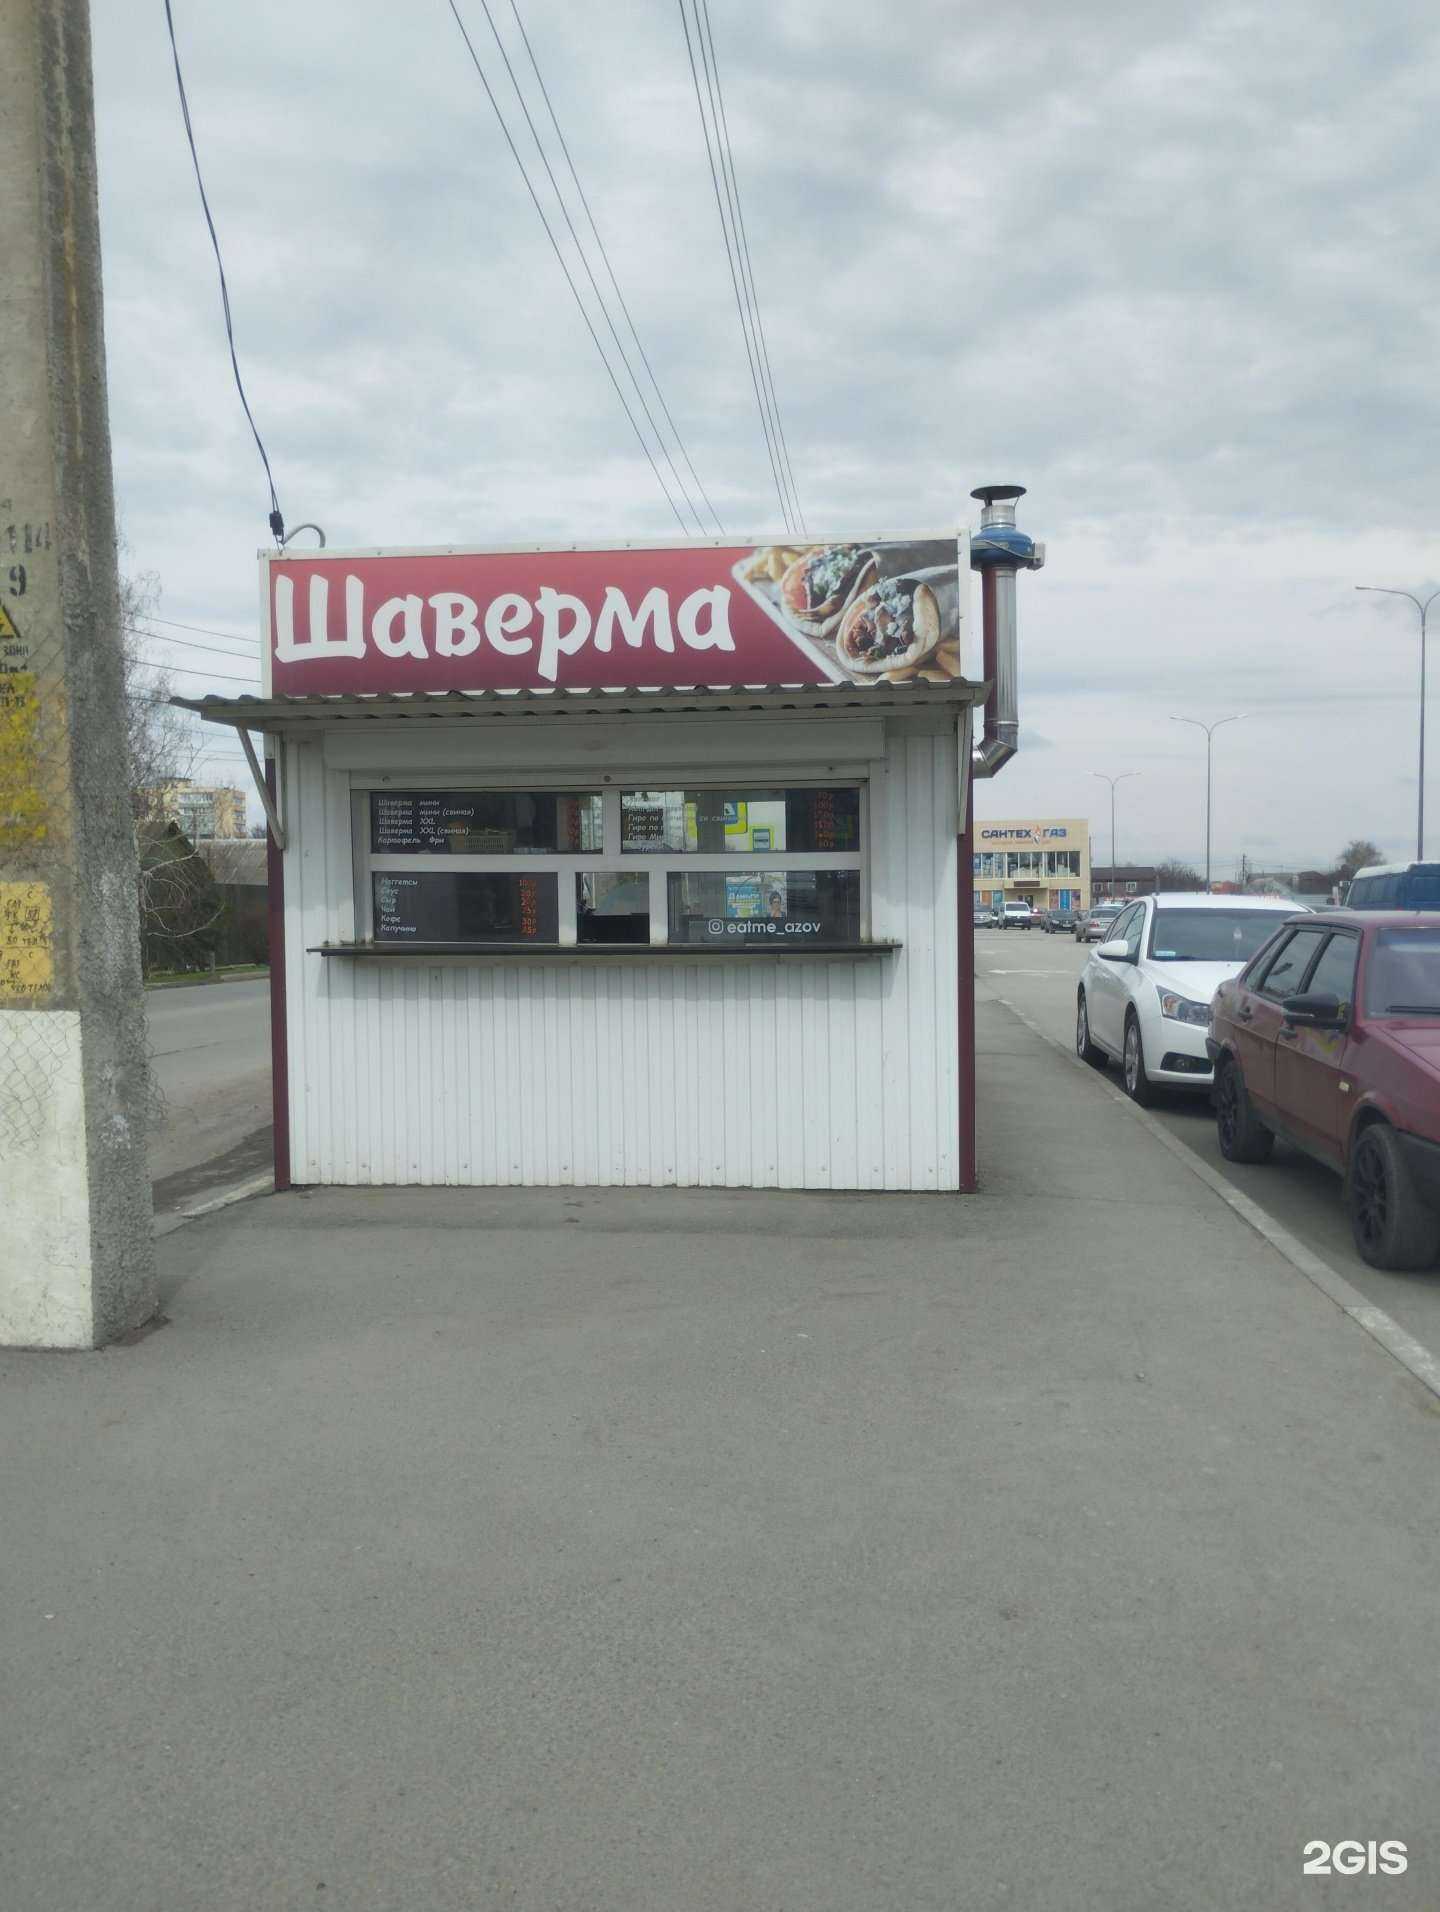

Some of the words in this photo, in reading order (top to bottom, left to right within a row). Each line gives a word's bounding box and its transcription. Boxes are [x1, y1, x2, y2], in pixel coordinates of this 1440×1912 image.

[273, 572, 736, 682] Шаверма
[419, 816, 436, 825] XXL
[419, 826, 436, 834] XXL
[981, 829, 1032, 839] САНТЕХ
[1042, 828, 1067, 838] ГАЗ
[727, 919, 822, 935] eatme_azov
